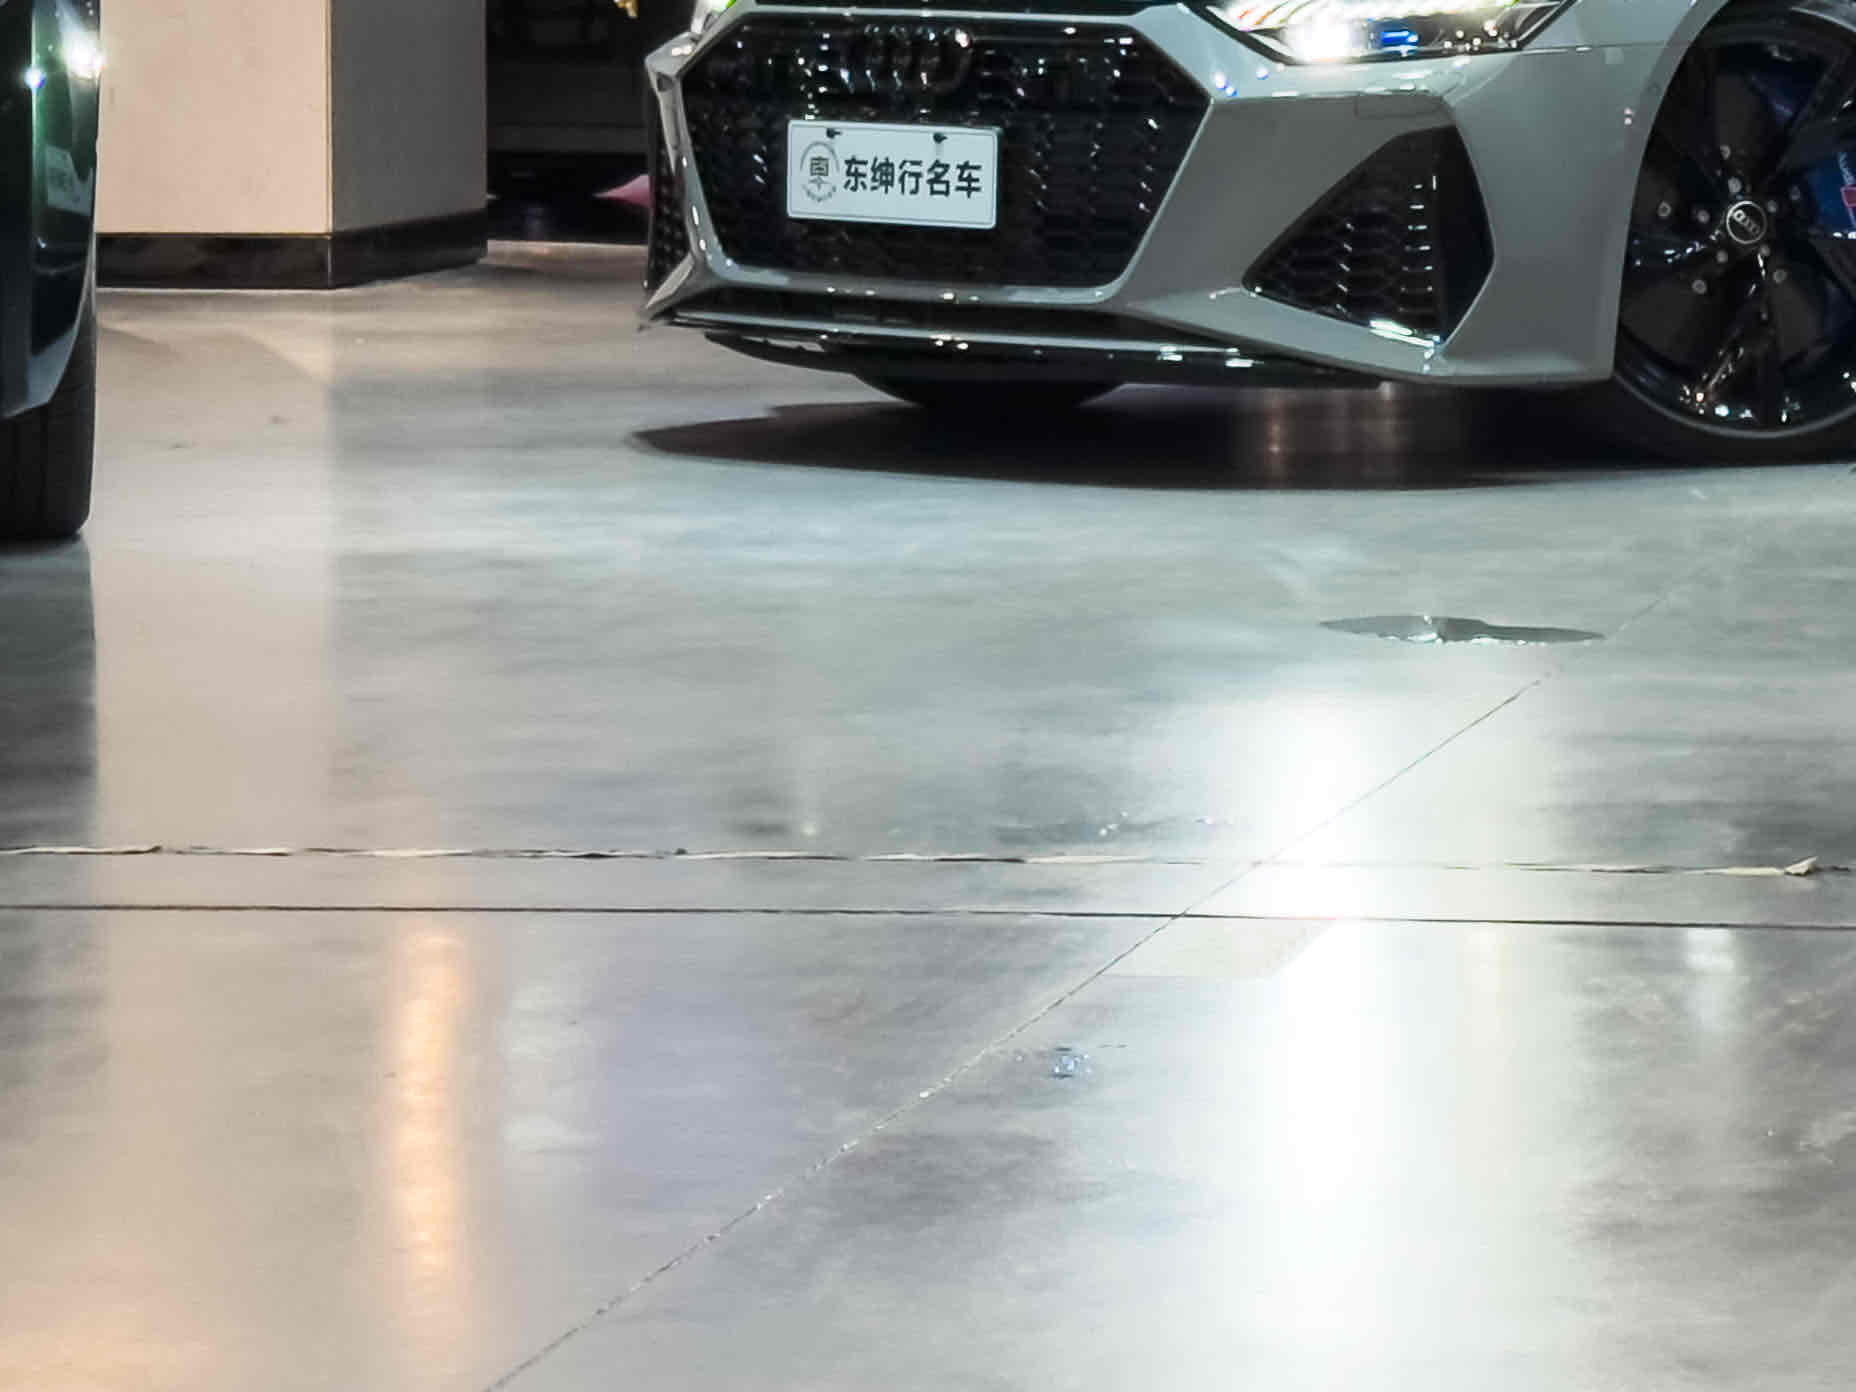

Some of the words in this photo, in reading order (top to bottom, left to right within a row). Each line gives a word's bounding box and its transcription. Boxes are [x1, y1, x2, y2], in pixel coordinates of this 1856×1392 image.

[843, 155, 982, 199] 东绅行名车
